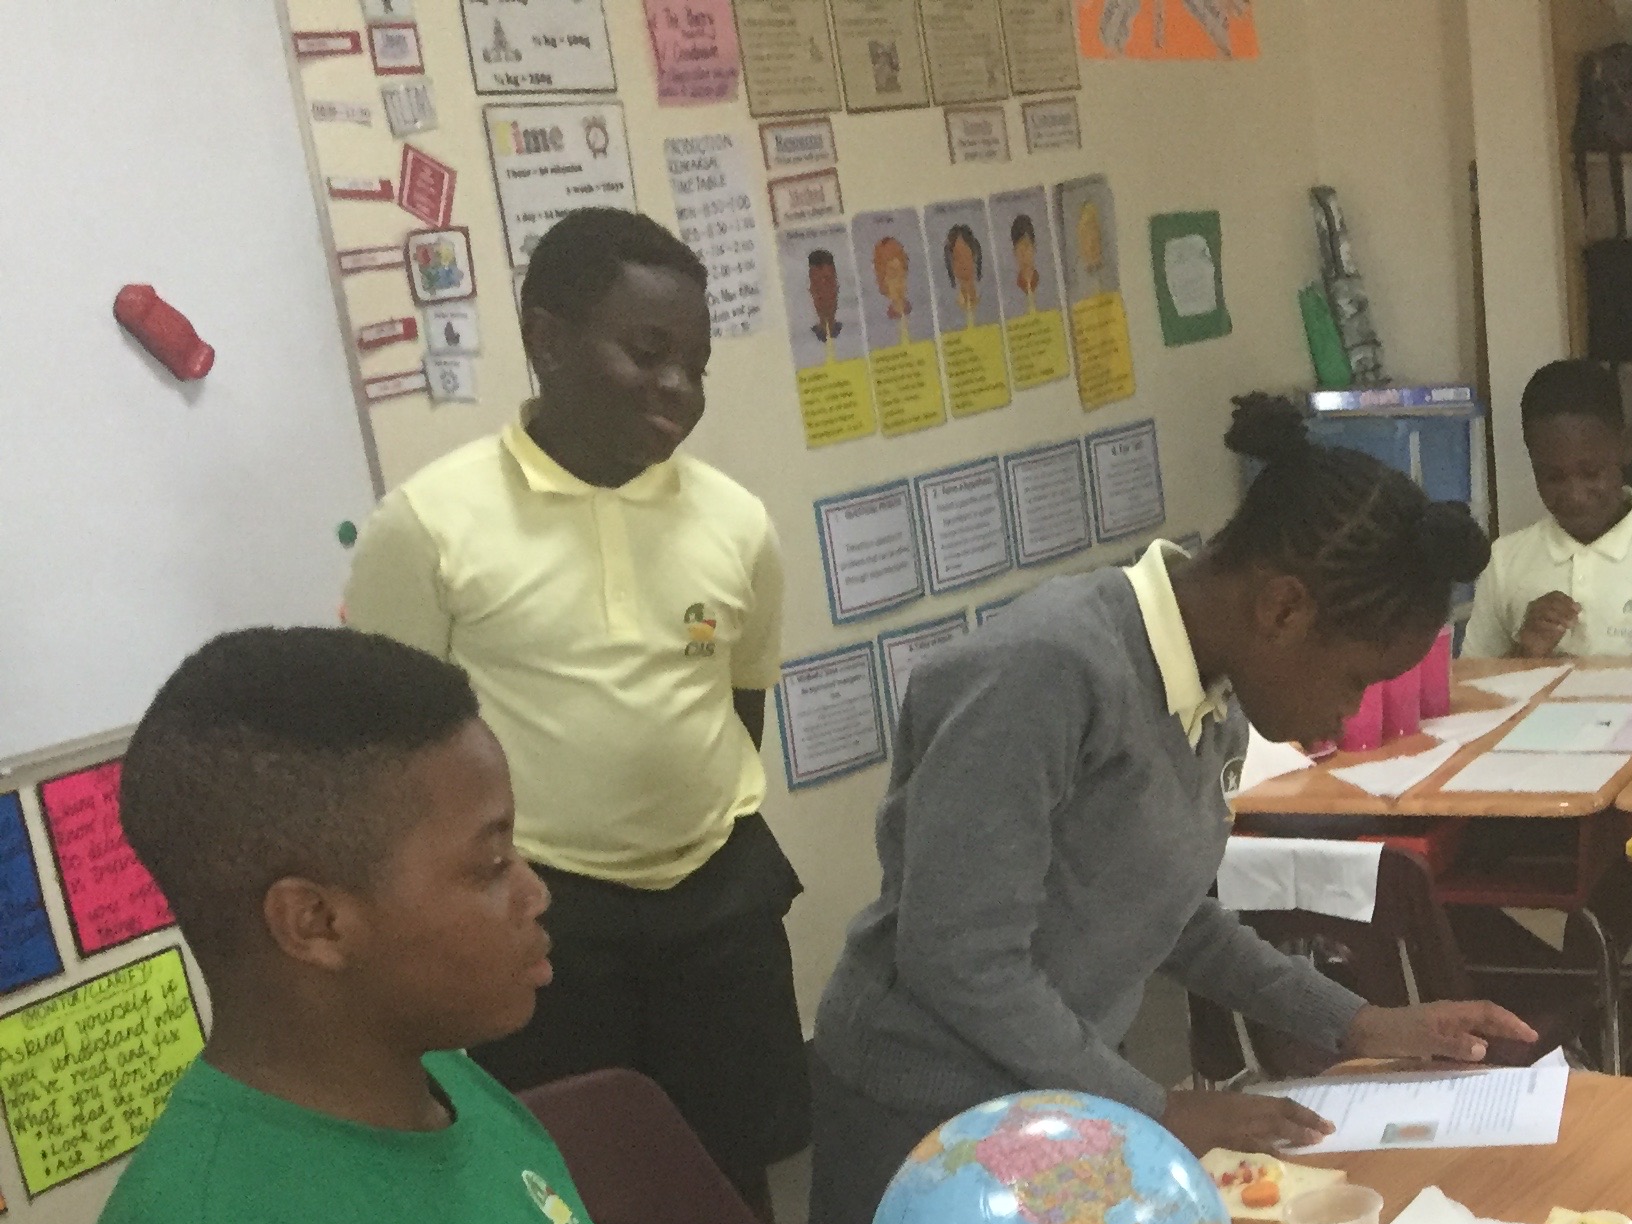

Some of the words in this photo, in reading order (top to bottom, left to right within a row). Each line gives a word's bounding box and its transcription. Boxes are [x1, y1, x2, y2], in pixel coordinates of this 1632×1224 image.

[75, 990, 152, 1036] yourself
[51, 1016, 148, 1075] understand
[117, 1040, 148, 1068] and
[69, 1084, 104, 1112] you
